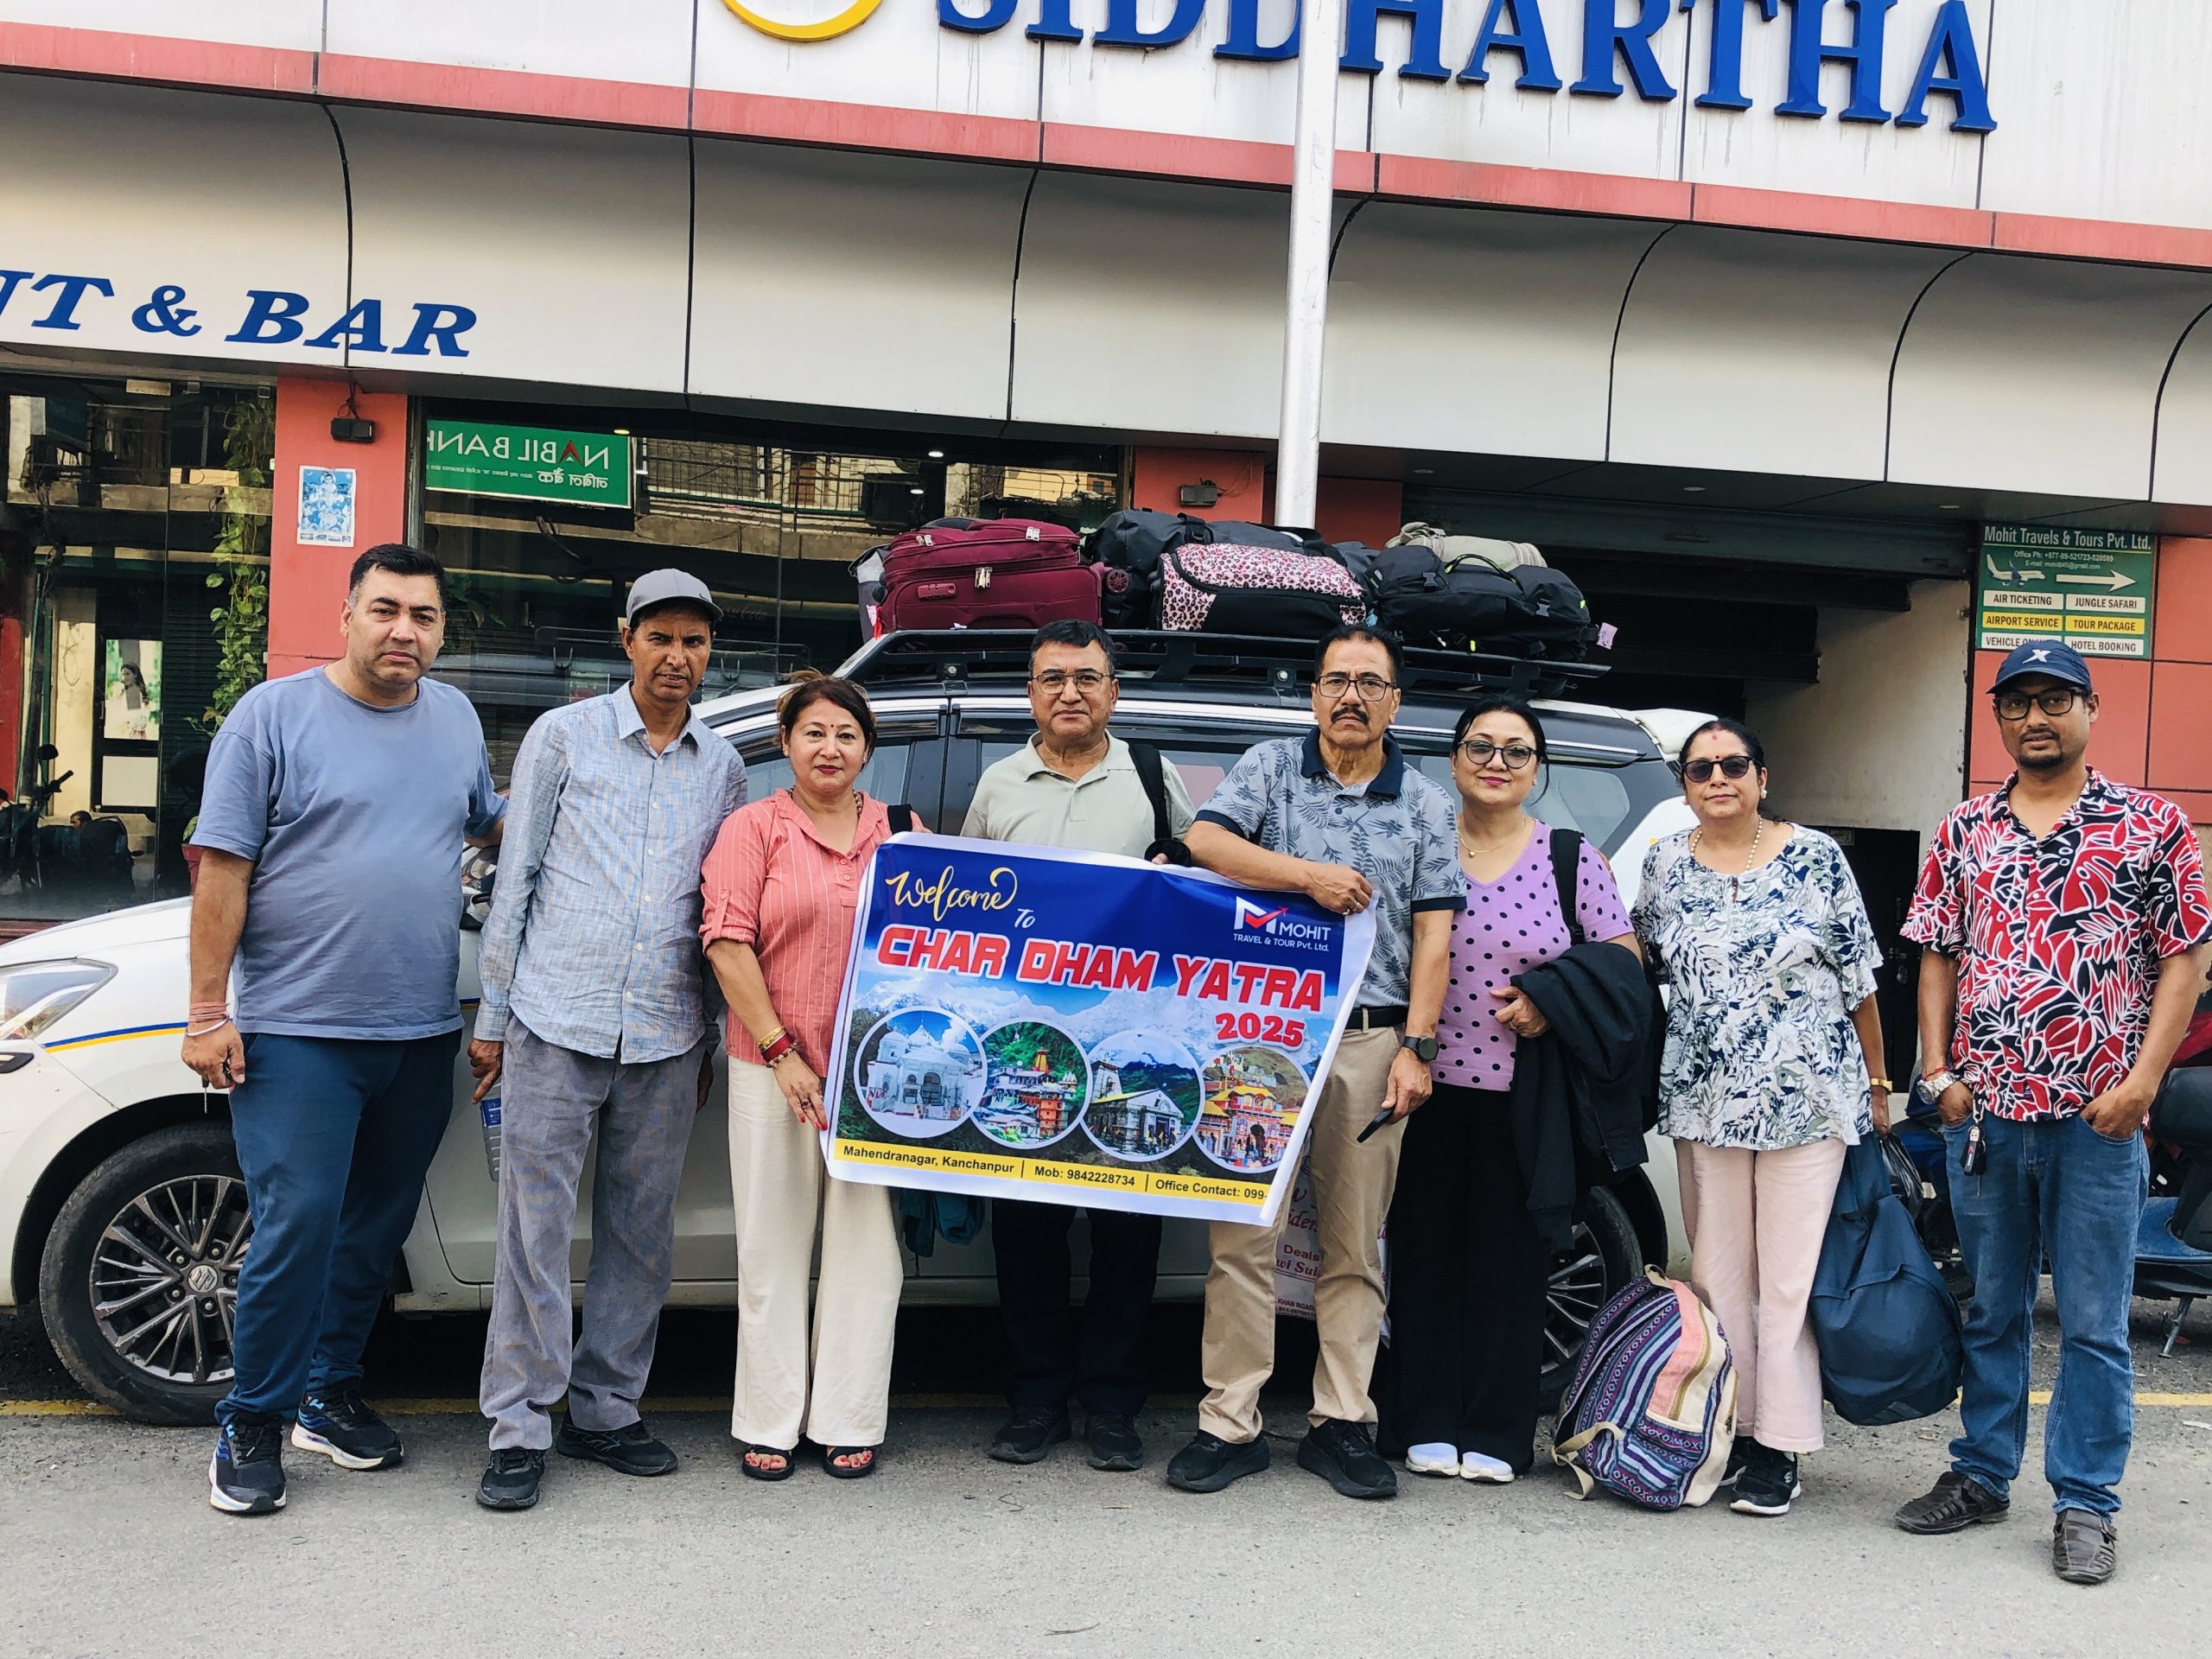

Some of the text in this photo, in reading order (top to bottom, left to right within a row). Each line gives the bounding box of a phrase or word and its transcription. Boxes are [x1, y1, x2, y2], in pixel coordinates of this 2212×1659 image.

[938, 0, 1998, 133] HARTHA
[131, 284, 202, 337] &
[224, 289, 478, 358] BAR
[1984, 525, 2152, 550] Mohit Travels & Tours Pvt. Ltd.
[2013, 550, 2031, 559] Office
[1993, 594, 2052, 606] AIR TICKETING
[2074, 597, 2138, 609] JUNGLE SAFARI
[1986, 615, 2059, 628] AIRPORT SERVICE
[2073, 619, 2136, 632] TOUR PACKAGE
[1986, 636, 2020, 647] VEHICLE
[2070, 640, 2137, 652] HOTEL BOOKING
[885, 865, 1018, 922] Welcome
[1014, 908, 1036, 929] To
[1279, 921, 1332, 941] MOHIT
[1233, 933, 1262, 944] TRAVEL
[1273, 938, 1295, 948] TOUR
[1296, 940, 1313, 950] Pvt.
[1314, 942, 1330, 952] Ltd.
[877, 925, 1324, 1013] CHAR DHAM YATRA
[1215, 1012, 1306, 1047] 2025
[843, 1145, 1014, 1175] Mahendranagar, Kanchanpur
[1034, 1165, 1135, 1187] Mob: 9842228734
[1155, 1179, 1189, 1192] Office
[1192, 1182, 1241, 1198] Contact:
[1283, 1243, 1320, 1262] Deals
[1294, 1261, 1320, 1277] Sui
